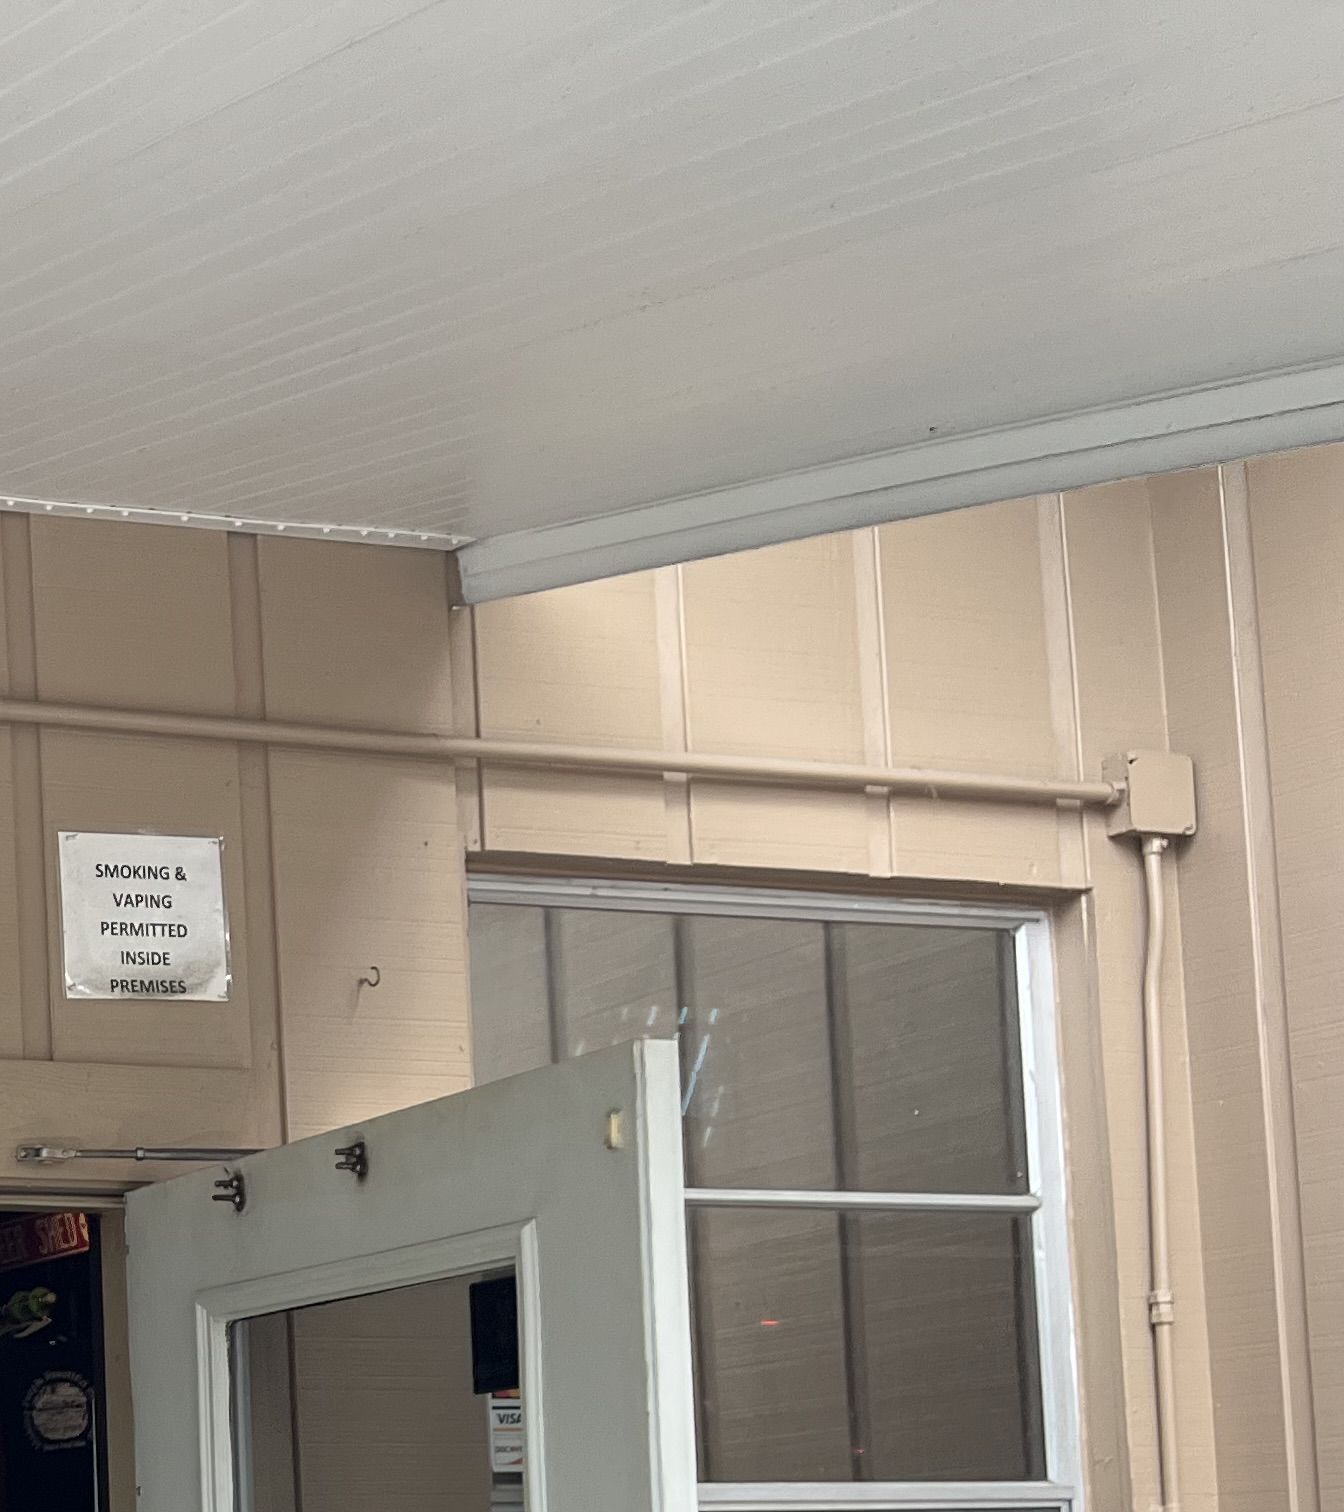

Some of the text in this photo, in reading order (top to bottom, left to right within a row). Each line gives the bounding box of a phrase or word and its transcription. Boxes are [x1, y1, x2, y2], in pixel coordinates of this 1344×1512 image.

[95, 863, 187, 882] SMOKING &
[112, 892, 172, 909] VAPING
[100, 921, 188, 938] PERMITTED
[120, 951, 171, 966] INSIDE
[110, 979, 187, 994] PREMISES
[35, 1213, 78, 1255] SHED
